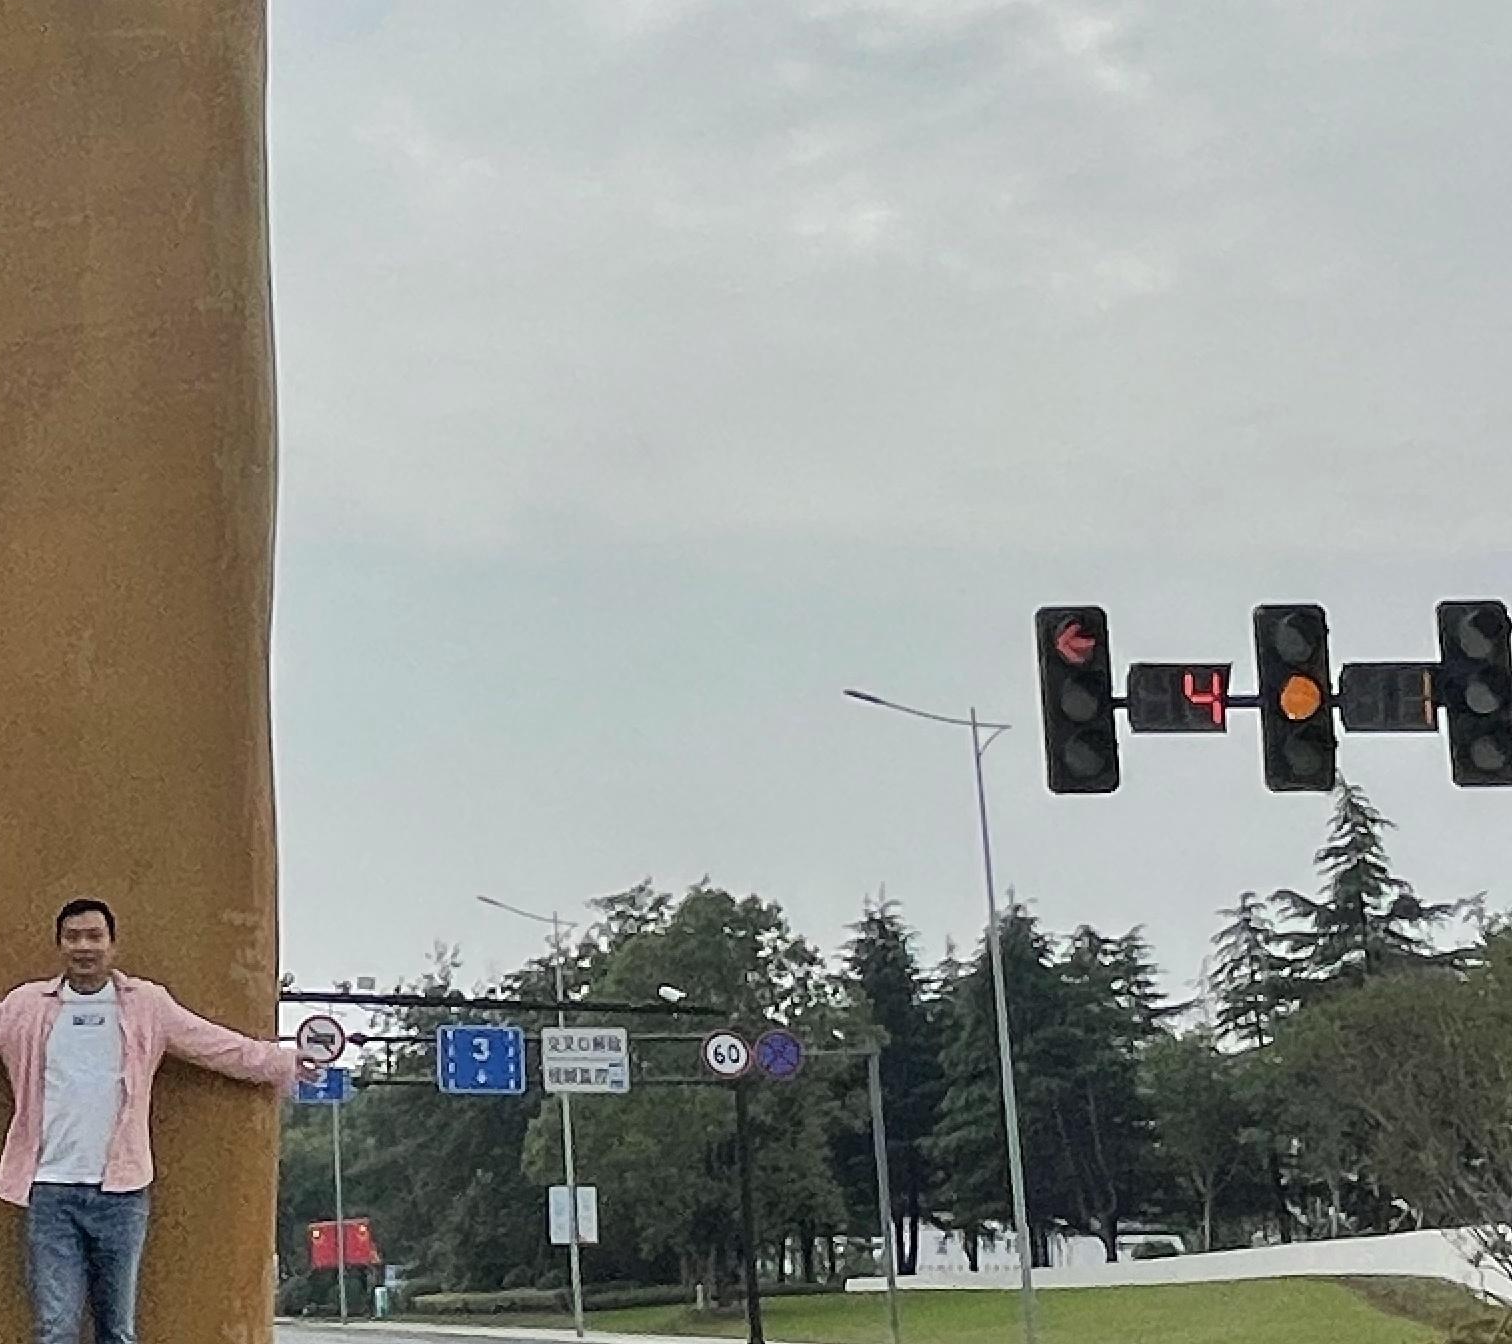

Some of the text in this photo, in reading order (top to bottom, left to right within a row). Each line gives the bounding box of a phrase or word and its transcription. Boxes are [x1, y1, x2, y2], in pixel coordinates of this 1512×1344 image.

[1184, 672, 1223, 725] 4
[472, 1037, 489, 1062] 3
[713, 1043, 740, 1065] 60
